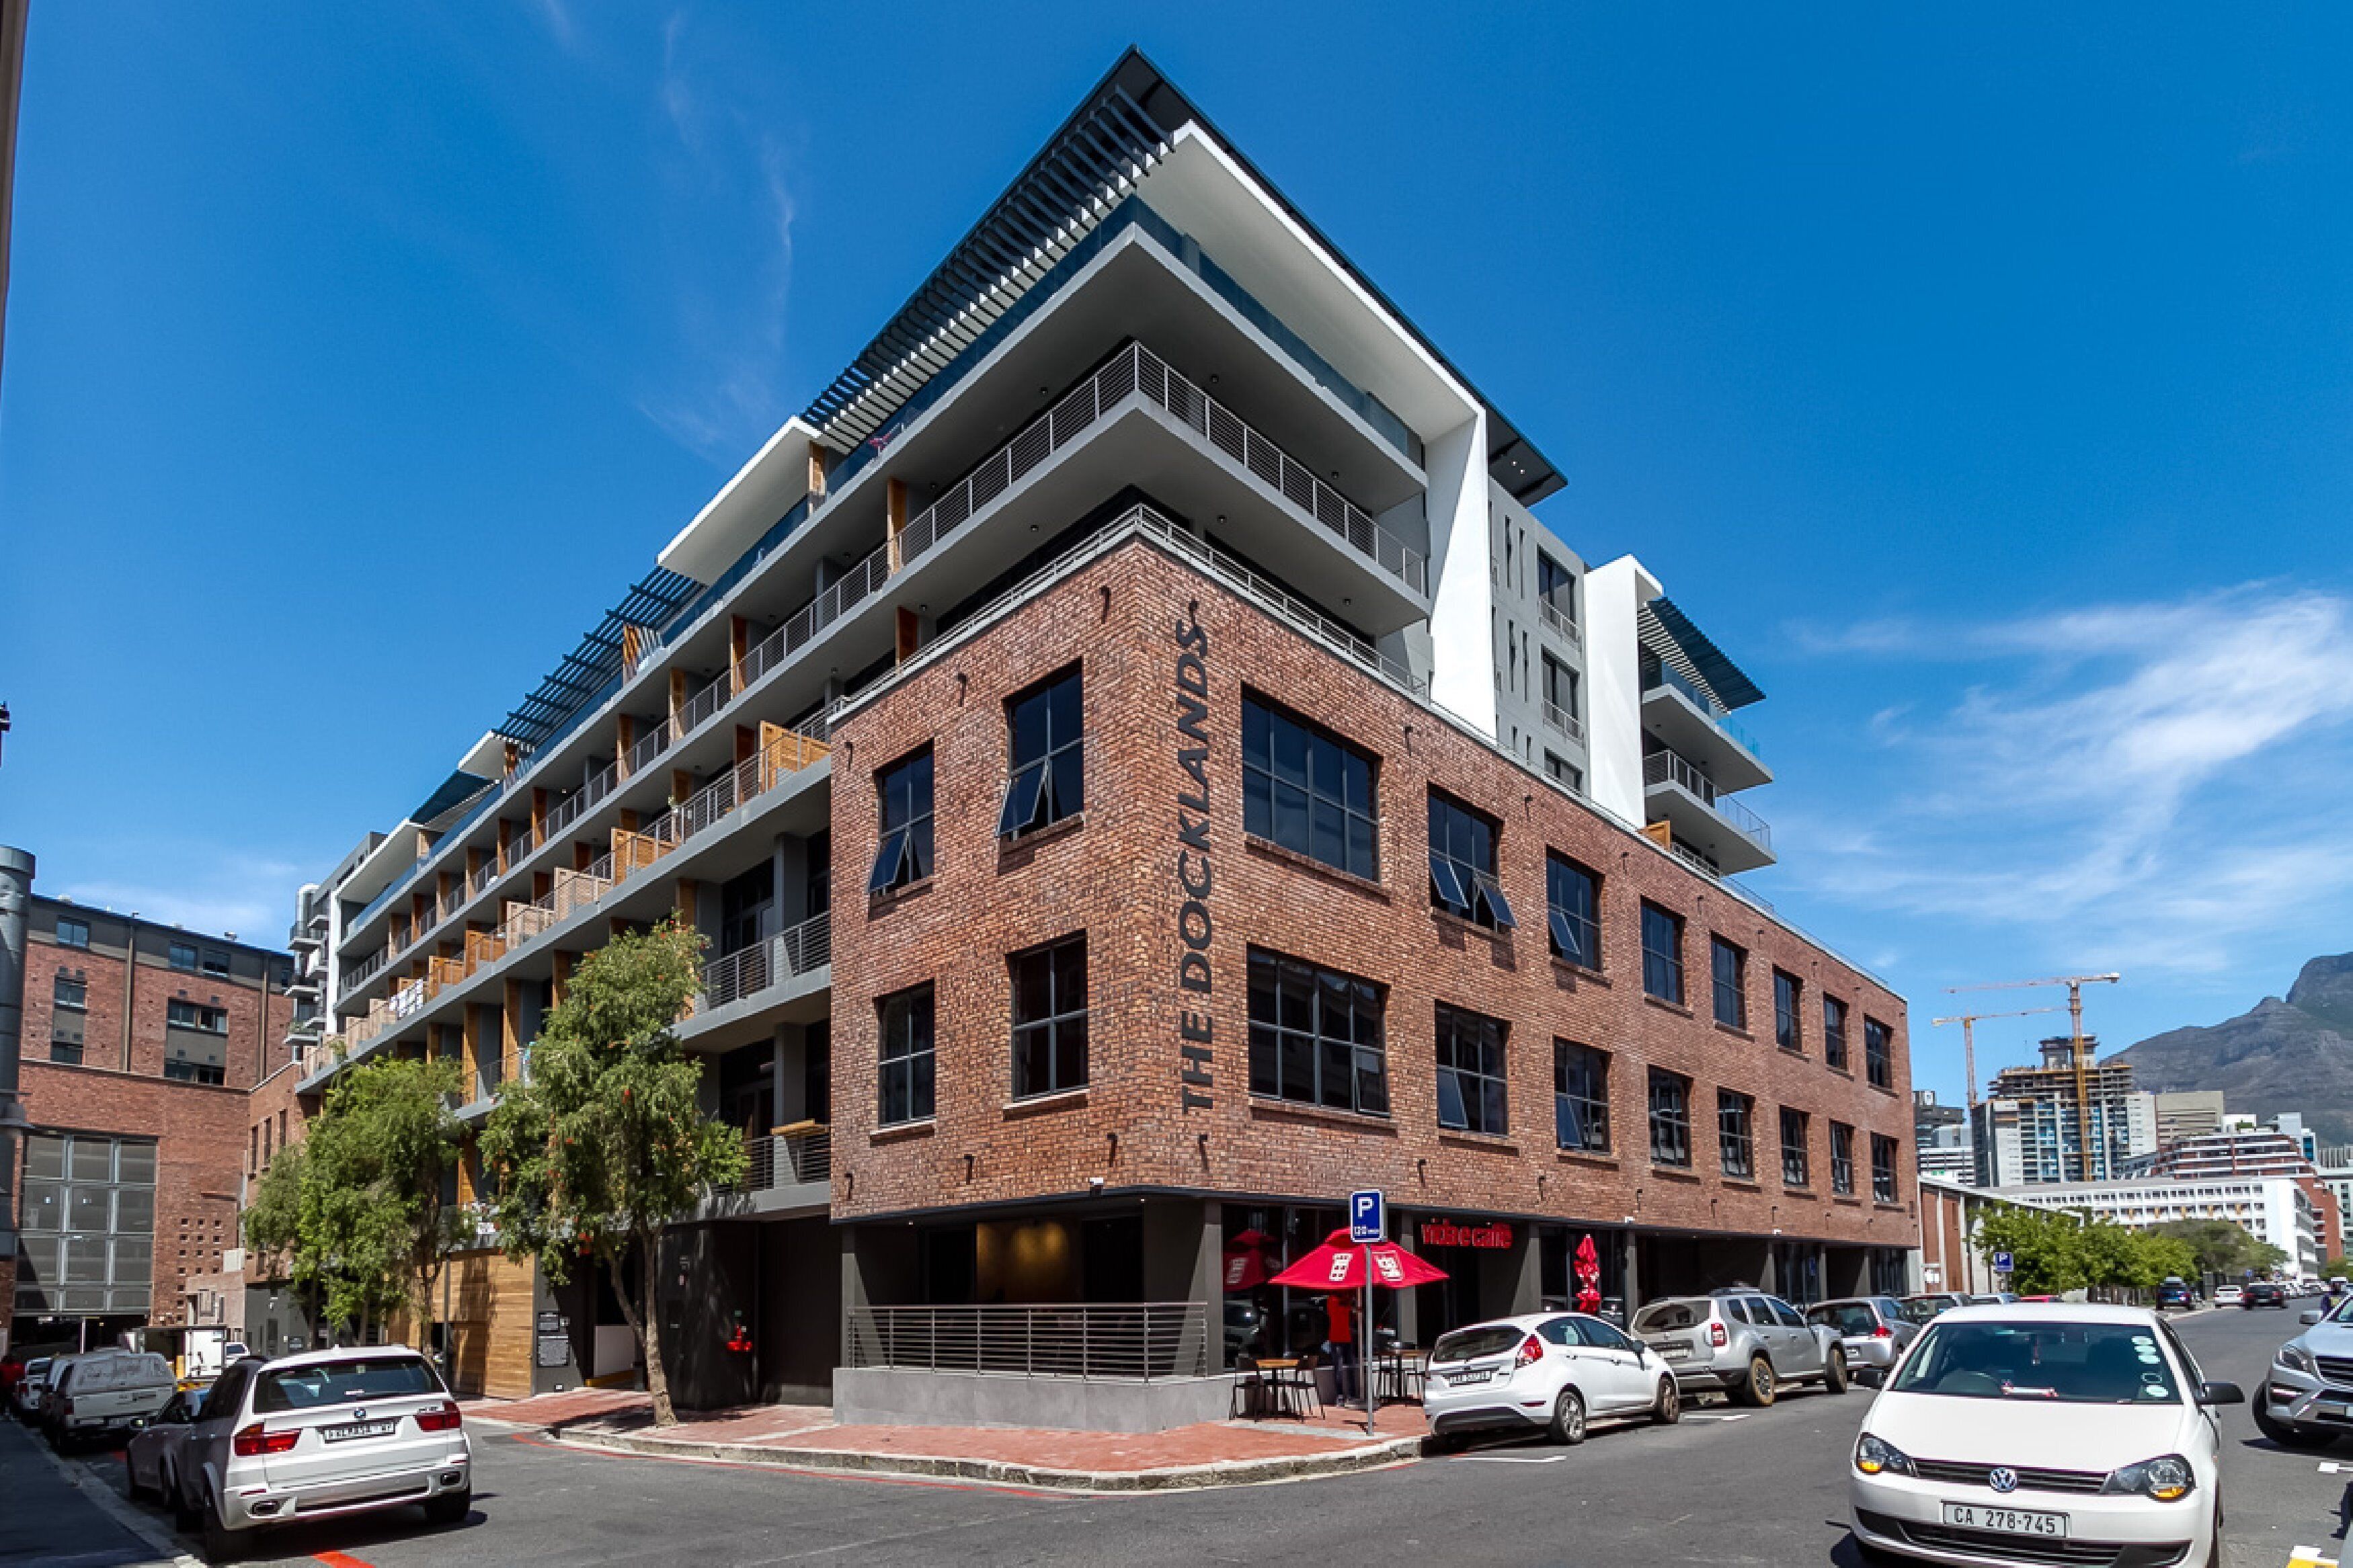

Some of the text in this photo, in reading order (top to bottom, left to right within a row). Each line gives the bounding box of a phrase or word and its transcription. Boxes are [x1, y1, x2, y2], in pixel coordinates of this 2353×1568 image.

[1175, 618, 1213, 1115] THE DOCKLANDS
[1357, 1196, 1374, 1219] P
[1954, 1507, 2055, 1534] CA 278-745
